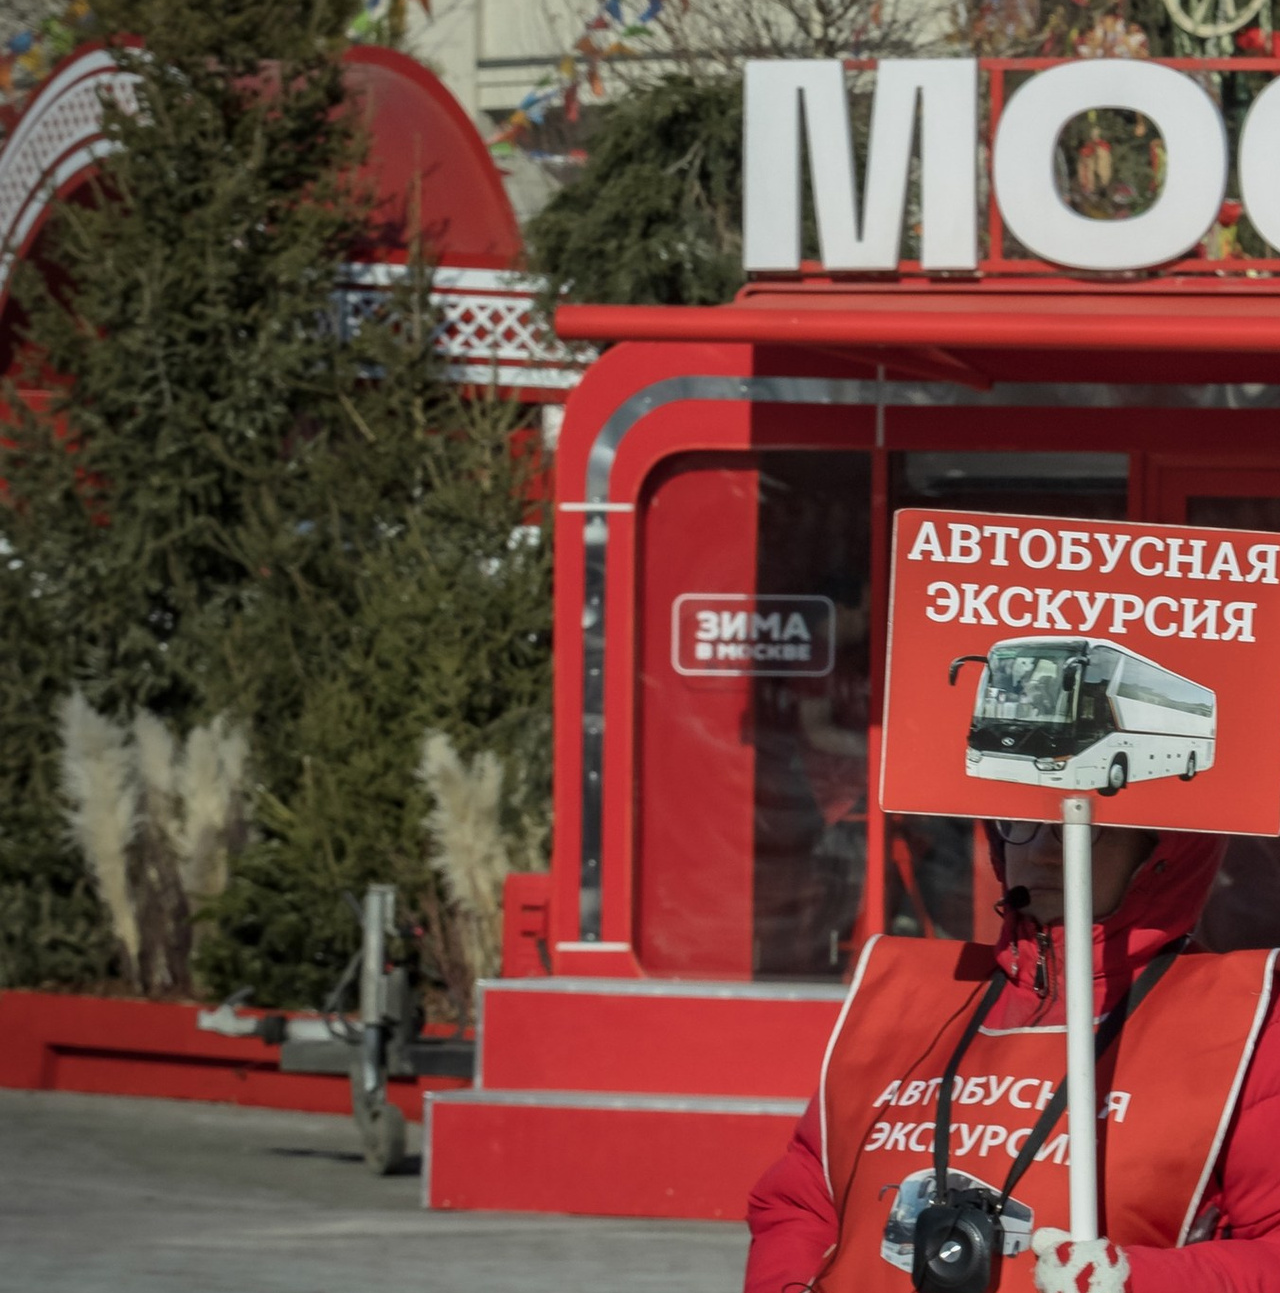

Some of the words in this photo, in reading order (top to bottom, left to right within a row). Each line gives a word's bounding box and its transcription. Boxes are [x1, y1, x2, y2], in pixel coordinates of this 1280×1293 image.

[907, 521, 1280, 584] АВТОБУСНАЯ
[694, 610, 811, 641] ЗИМА
[925, 581, 1257, 643] ЭКСКУРСИЯ
[694, 644, 712, 660] В
[716, 644, 811, 661] МОСКВЕ
